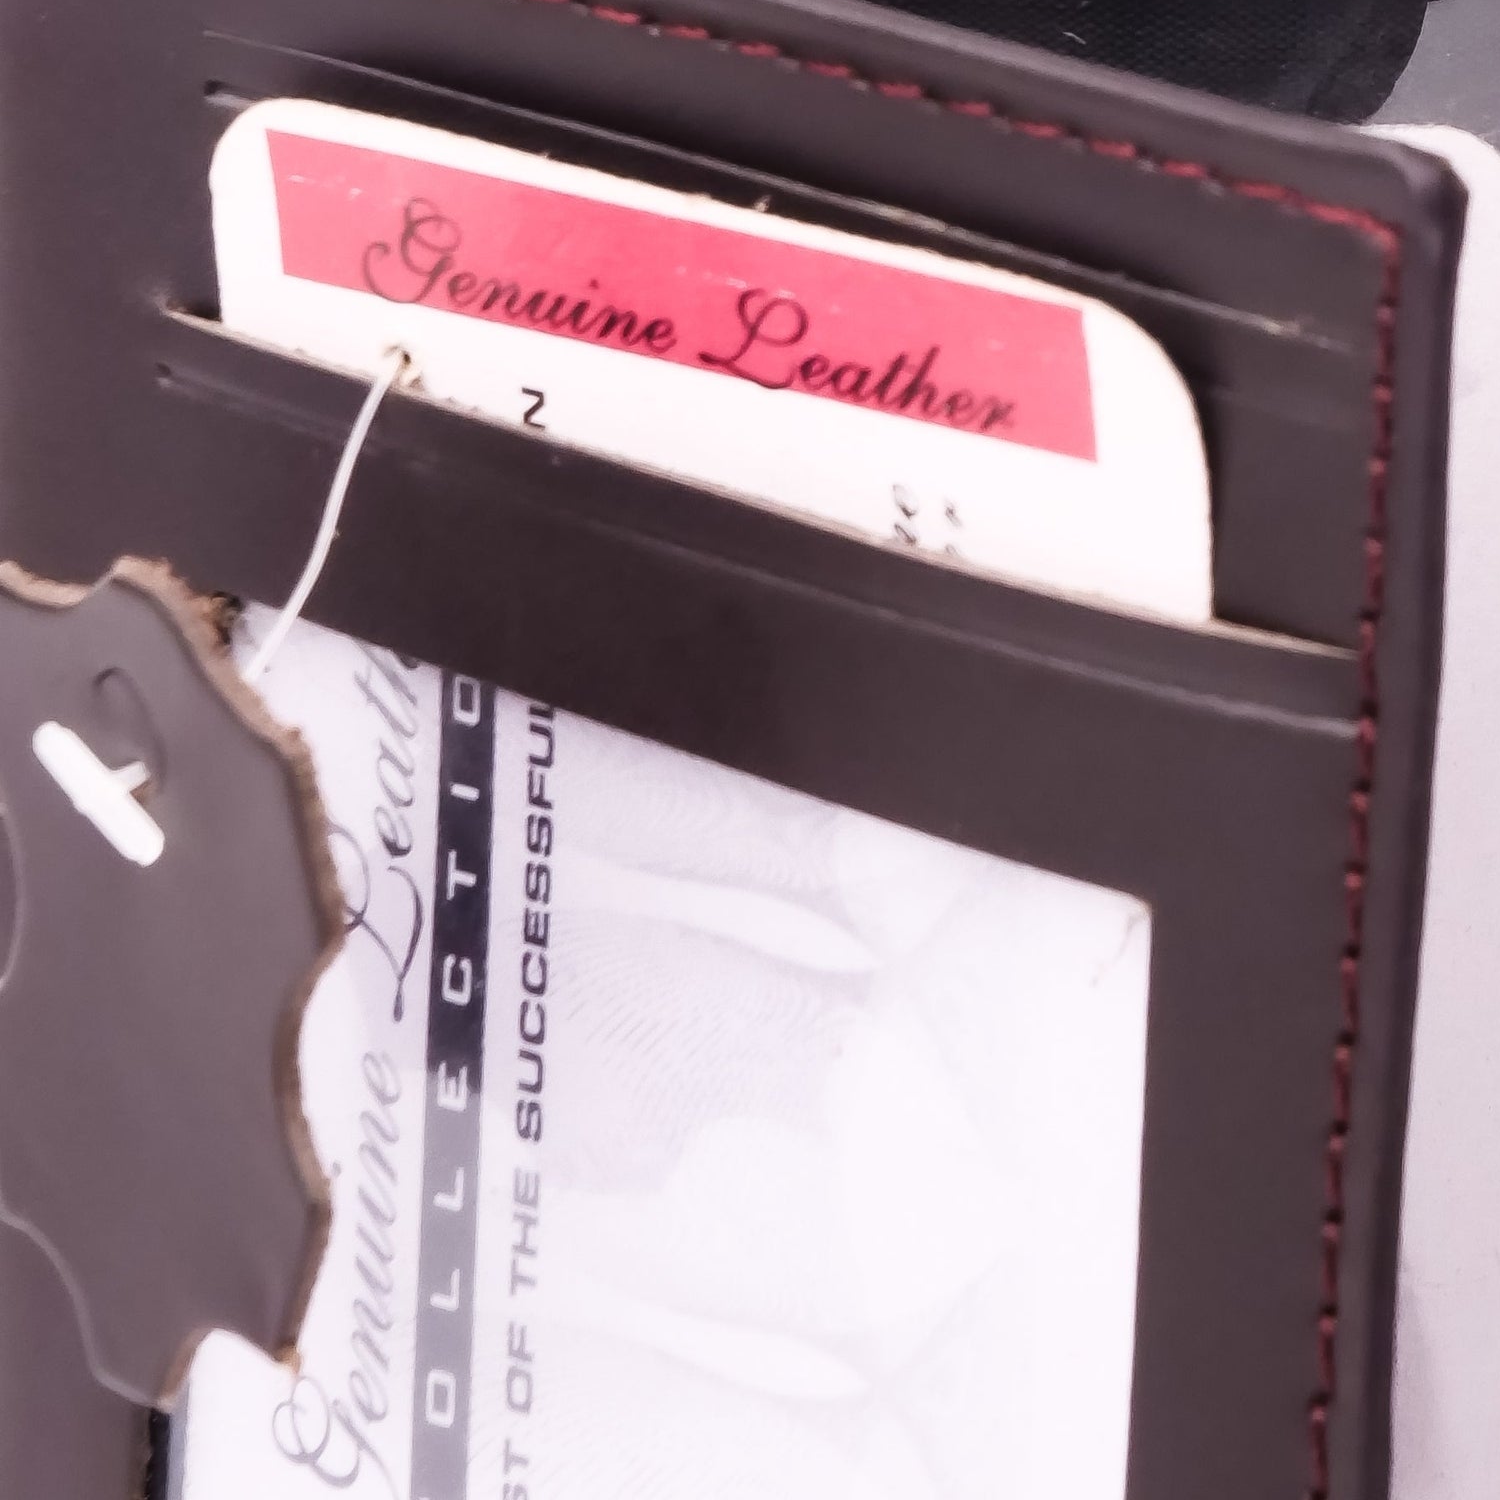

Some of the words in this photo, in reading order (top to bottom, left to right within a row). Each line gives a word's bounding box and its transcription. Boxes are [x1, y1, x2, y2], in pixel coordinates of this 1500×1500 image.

[362, 197, 677, 354] Genuine
[697, 287, 1016, 431] Leather
[419, 674, 482, 1500] OLLECTIO
[272, 1050, 402, 1500] Genuine
[510, 1168, 542, 1295] THE
[504, 1321, 536, 1414] OF
